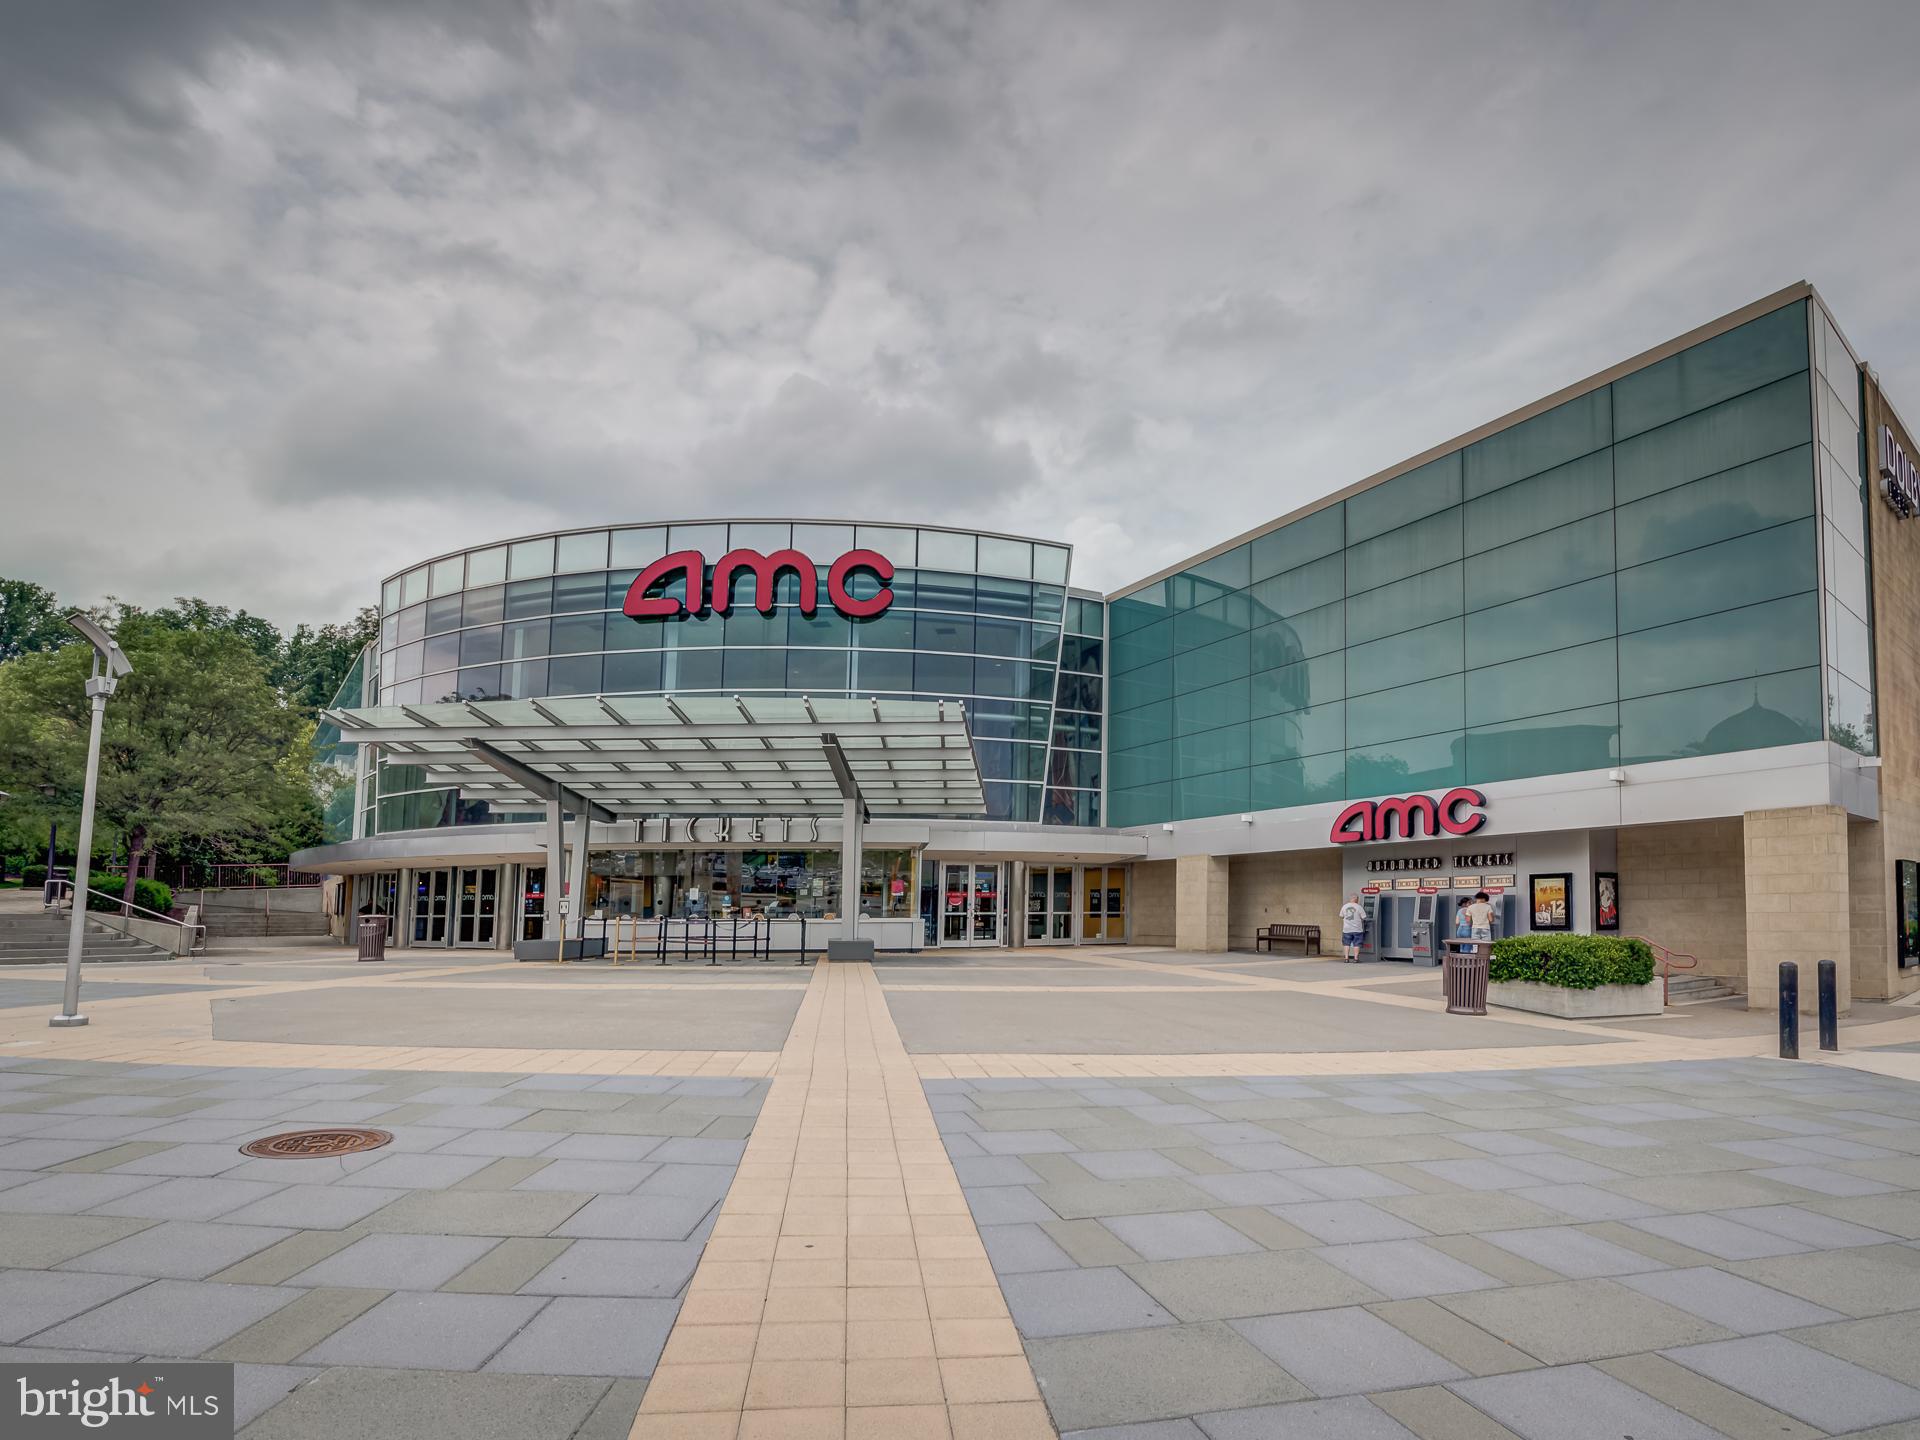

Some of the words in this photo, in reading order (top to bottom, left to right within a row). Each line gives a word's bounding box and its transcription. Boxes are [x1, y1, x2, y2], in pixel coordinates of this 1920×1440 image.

[633, 817, 822, 842] TICKETS
[1367, 857, 1441, 872] AUTOMATED
[1452, 853, 1514, 868] TICKETS
